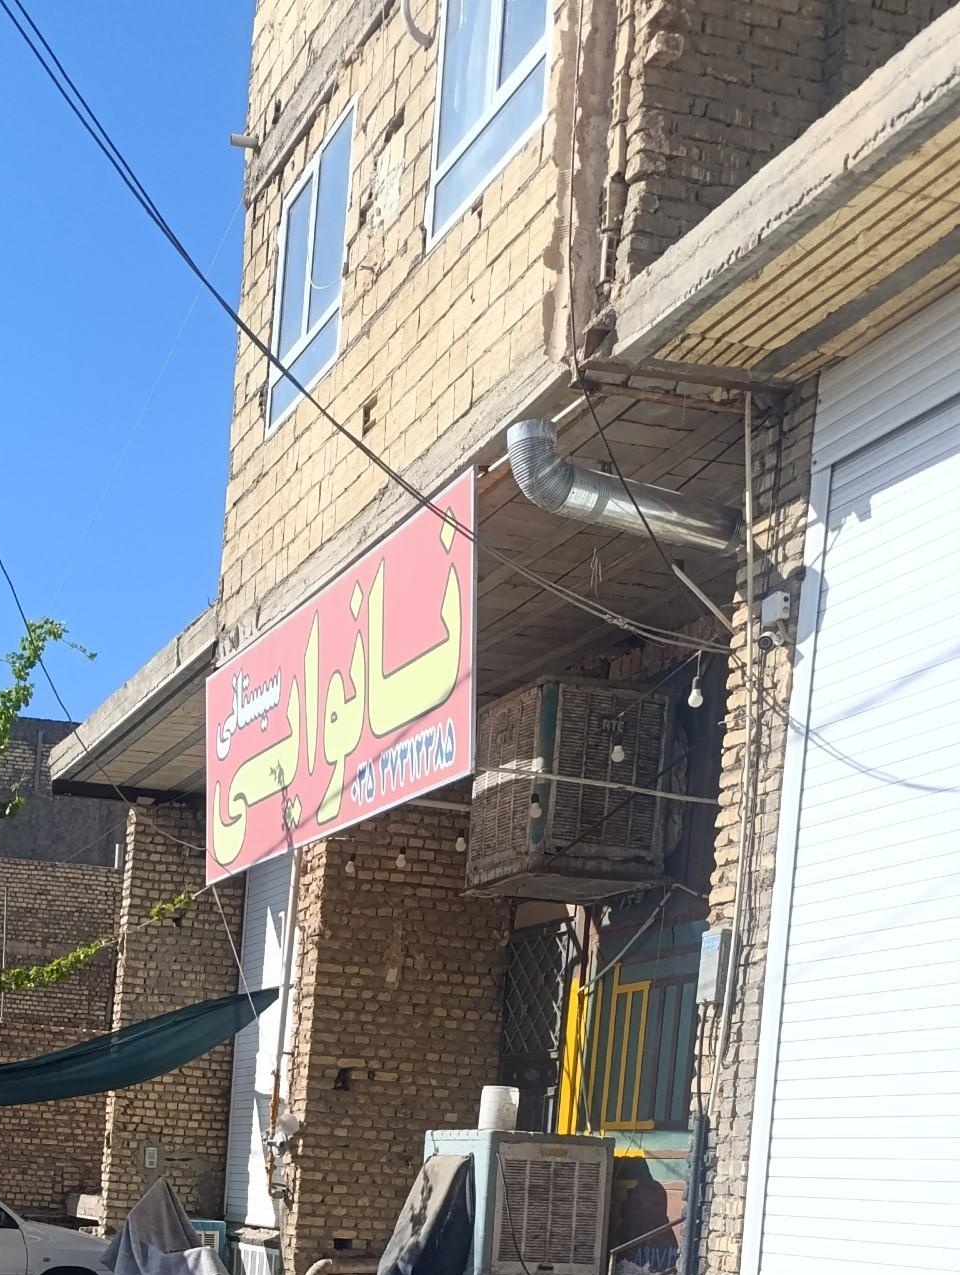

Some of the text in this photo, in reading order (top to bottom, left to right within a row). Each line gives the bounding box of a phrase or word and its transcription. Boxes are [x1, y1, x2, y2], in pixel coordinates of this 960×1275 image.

[212, 505, 462, 866] نانوایی
[215, 665, 282, 761] سیستانی
[351, 758, 376, 806] ۰۳۵
